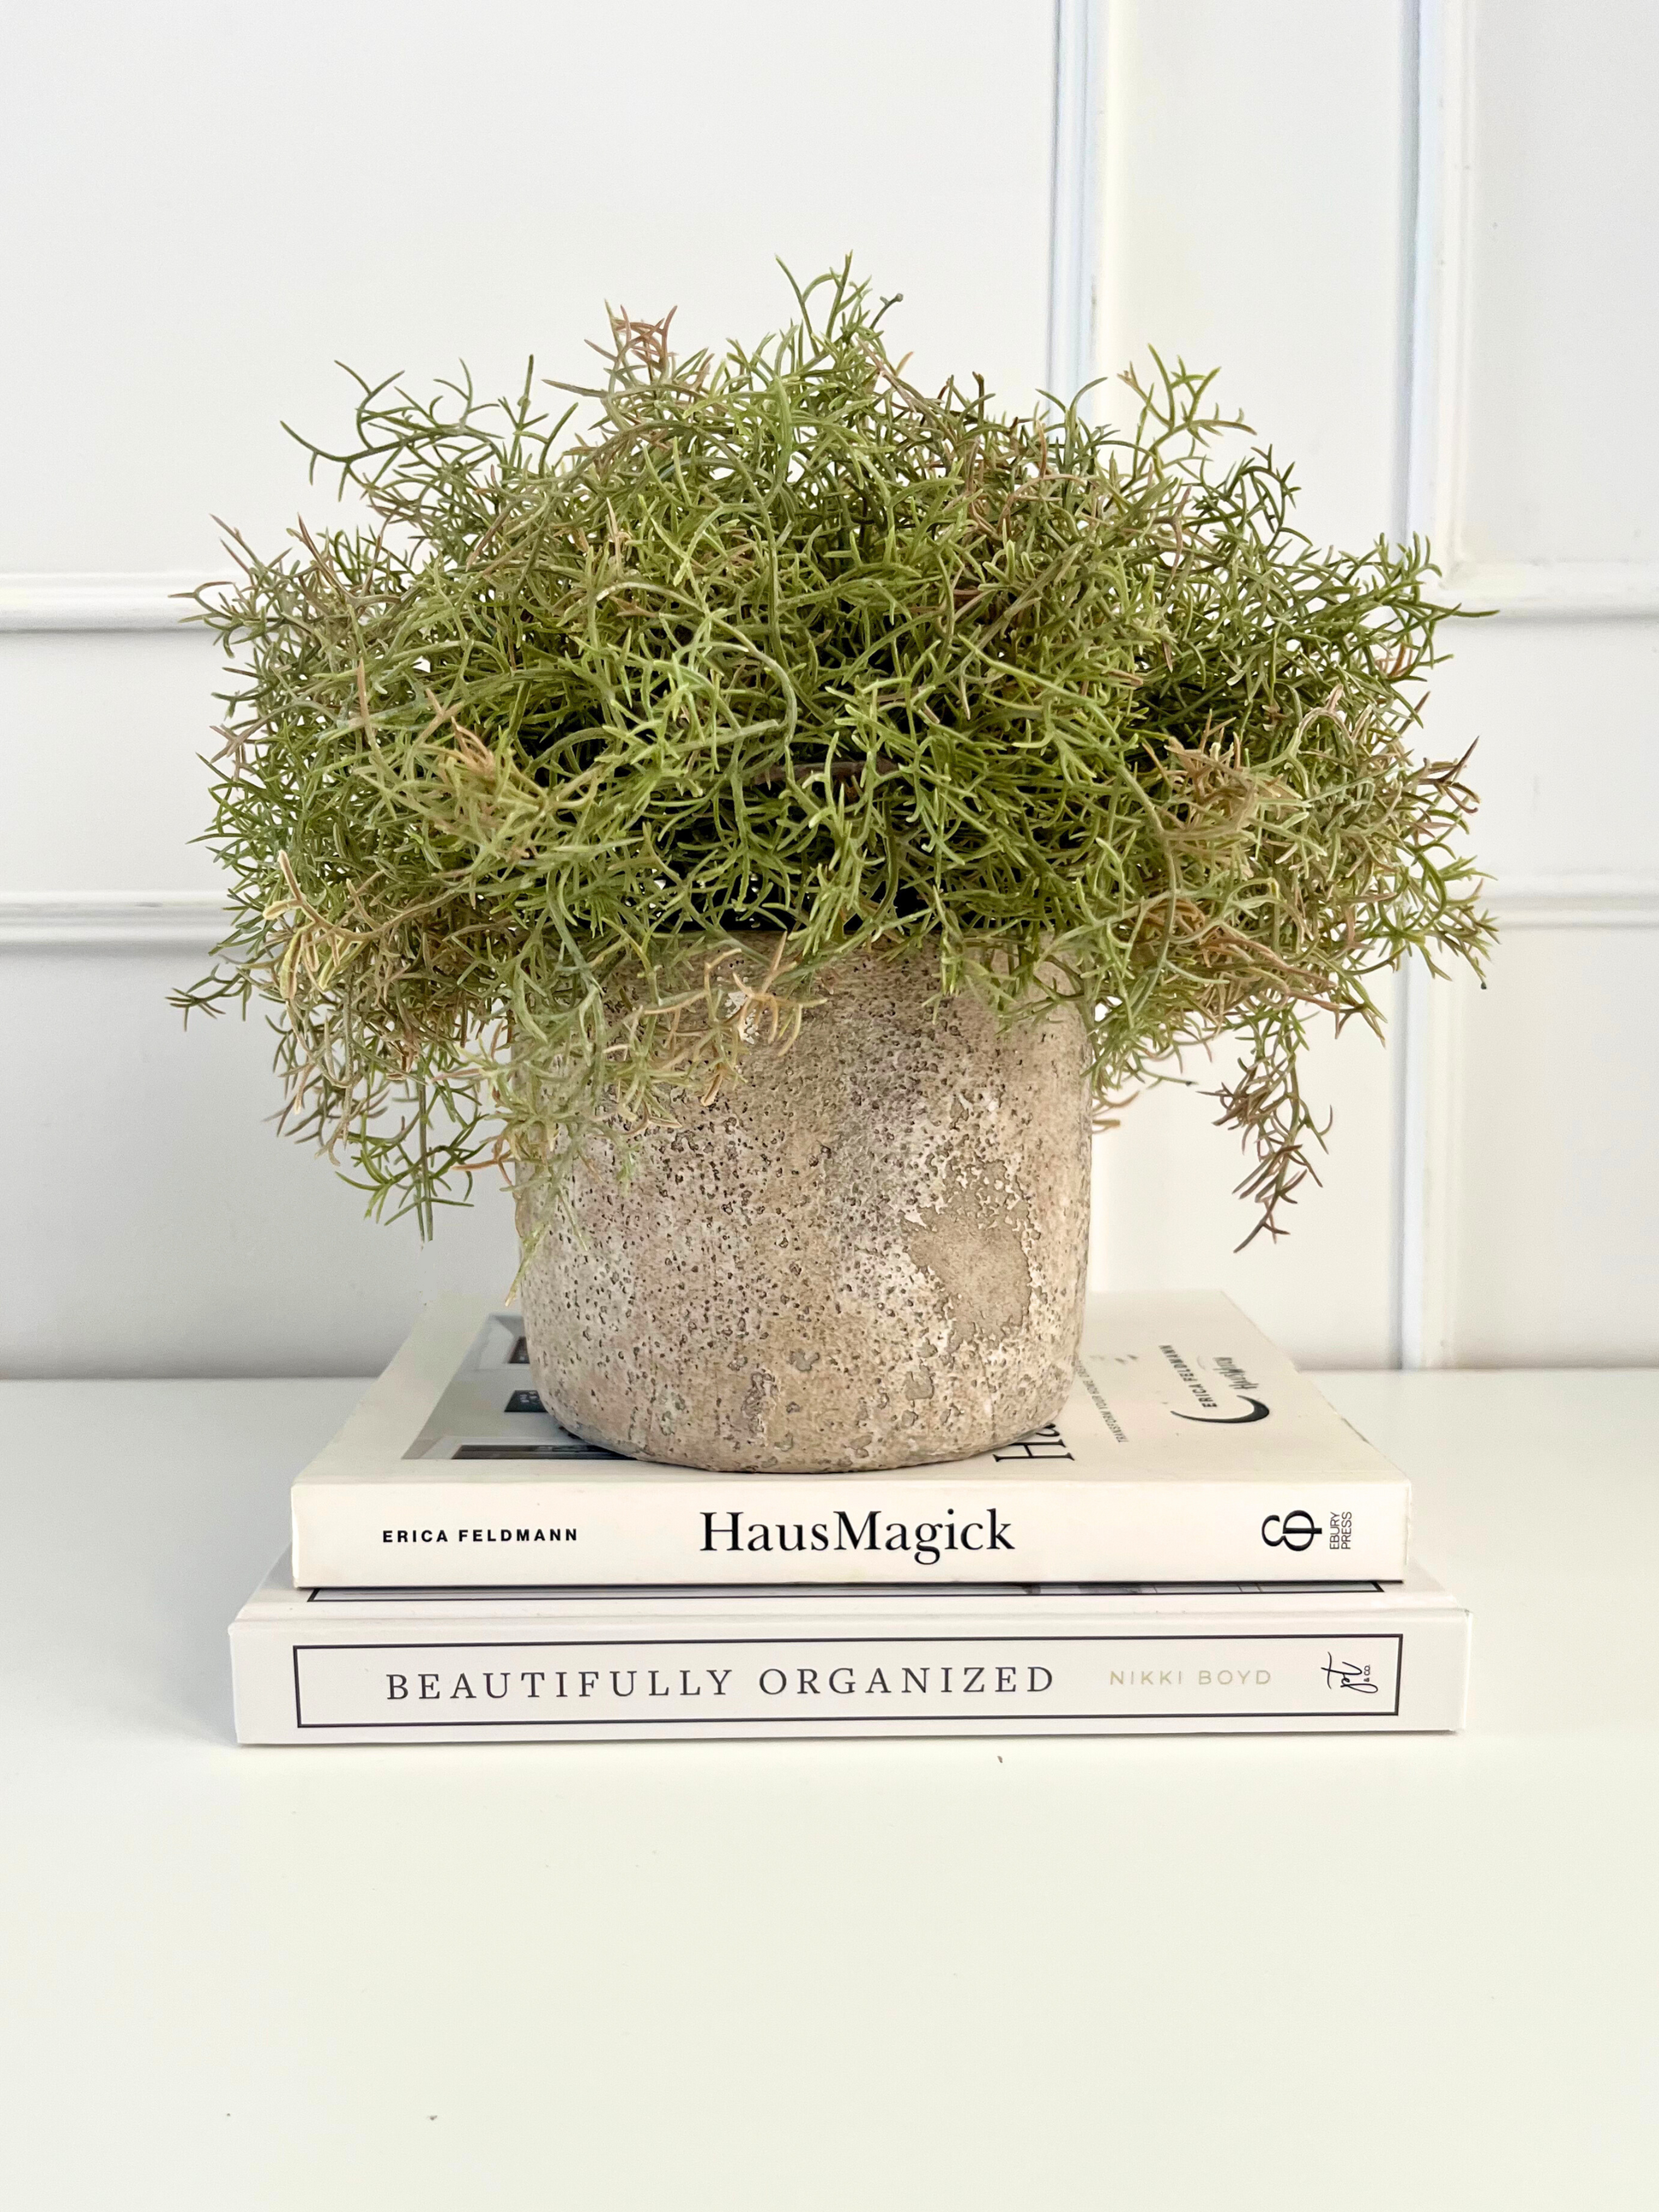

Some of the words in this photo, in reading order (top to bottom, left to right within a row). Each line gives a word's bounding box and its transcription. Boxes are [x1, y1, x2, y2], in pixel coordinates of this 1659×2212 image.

[1159, 1345, 1198, 1382] FELDMANN
[1091, 1395, 1108, 1410] YOUR
[1189, 1383, 1217, 1407] ERICA
[1101, 1411, 1130, 1442] TRANSFORM
[383, 1529, 448, 1543] ERICA
[459, 1528, 578, 1542] FELDMANN
[700, 1508, 1015, 1566] HausMagick
[1329, 1511, 1339, 1550] EBURY
[1341, 1511, 1352, 1550] PRESS
[385, 1668, 733, 1701] BEAUTIFULLY
[759, 1666, 1054, 1695] ORGANIZED
[1109, 1670, 1182, 1685] NIKKI
[1198, 1669, 1271, 1685] BOYD
